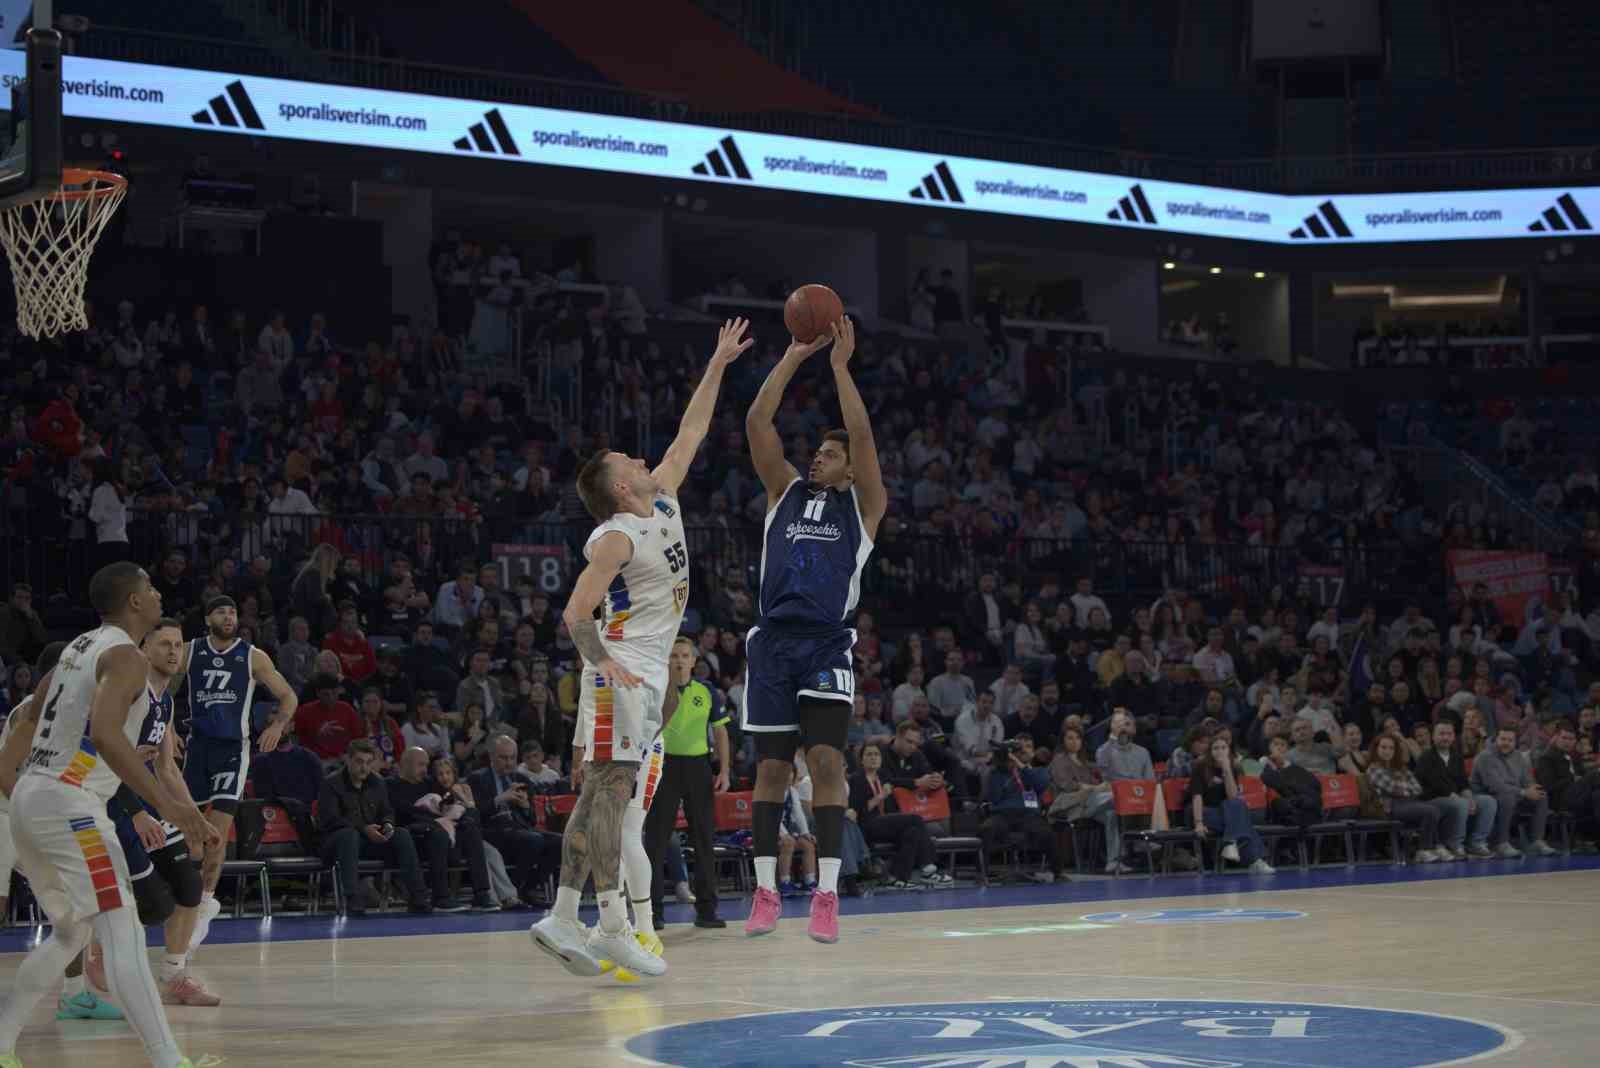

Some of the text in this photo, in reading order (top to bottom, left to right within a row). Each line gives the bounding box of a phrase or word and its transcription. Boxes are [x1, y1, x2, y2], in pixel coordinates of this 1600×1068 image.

[279, 102, 427, 130] sporalisverisim.com
[532, 129, 669, 157] sporalisverisim.com
[763, 155, 888, 182] sporalisverisim.com
[974, 180, 1088, 204] sporalisverisim.com
[1166, 202, 1271, 224] sporalisverisim.com
[1365, 207, 1503, 228] sporalisverisim.com
[803, 500, 826, 521] 11
[664, 541, 686, 573] 55
[1314, 576, 1345, 607] 17
[203, 669, 232, 690] 77
[211, 771, 236, 791] 77
[780, 1016, 1328, 1039] BAU
